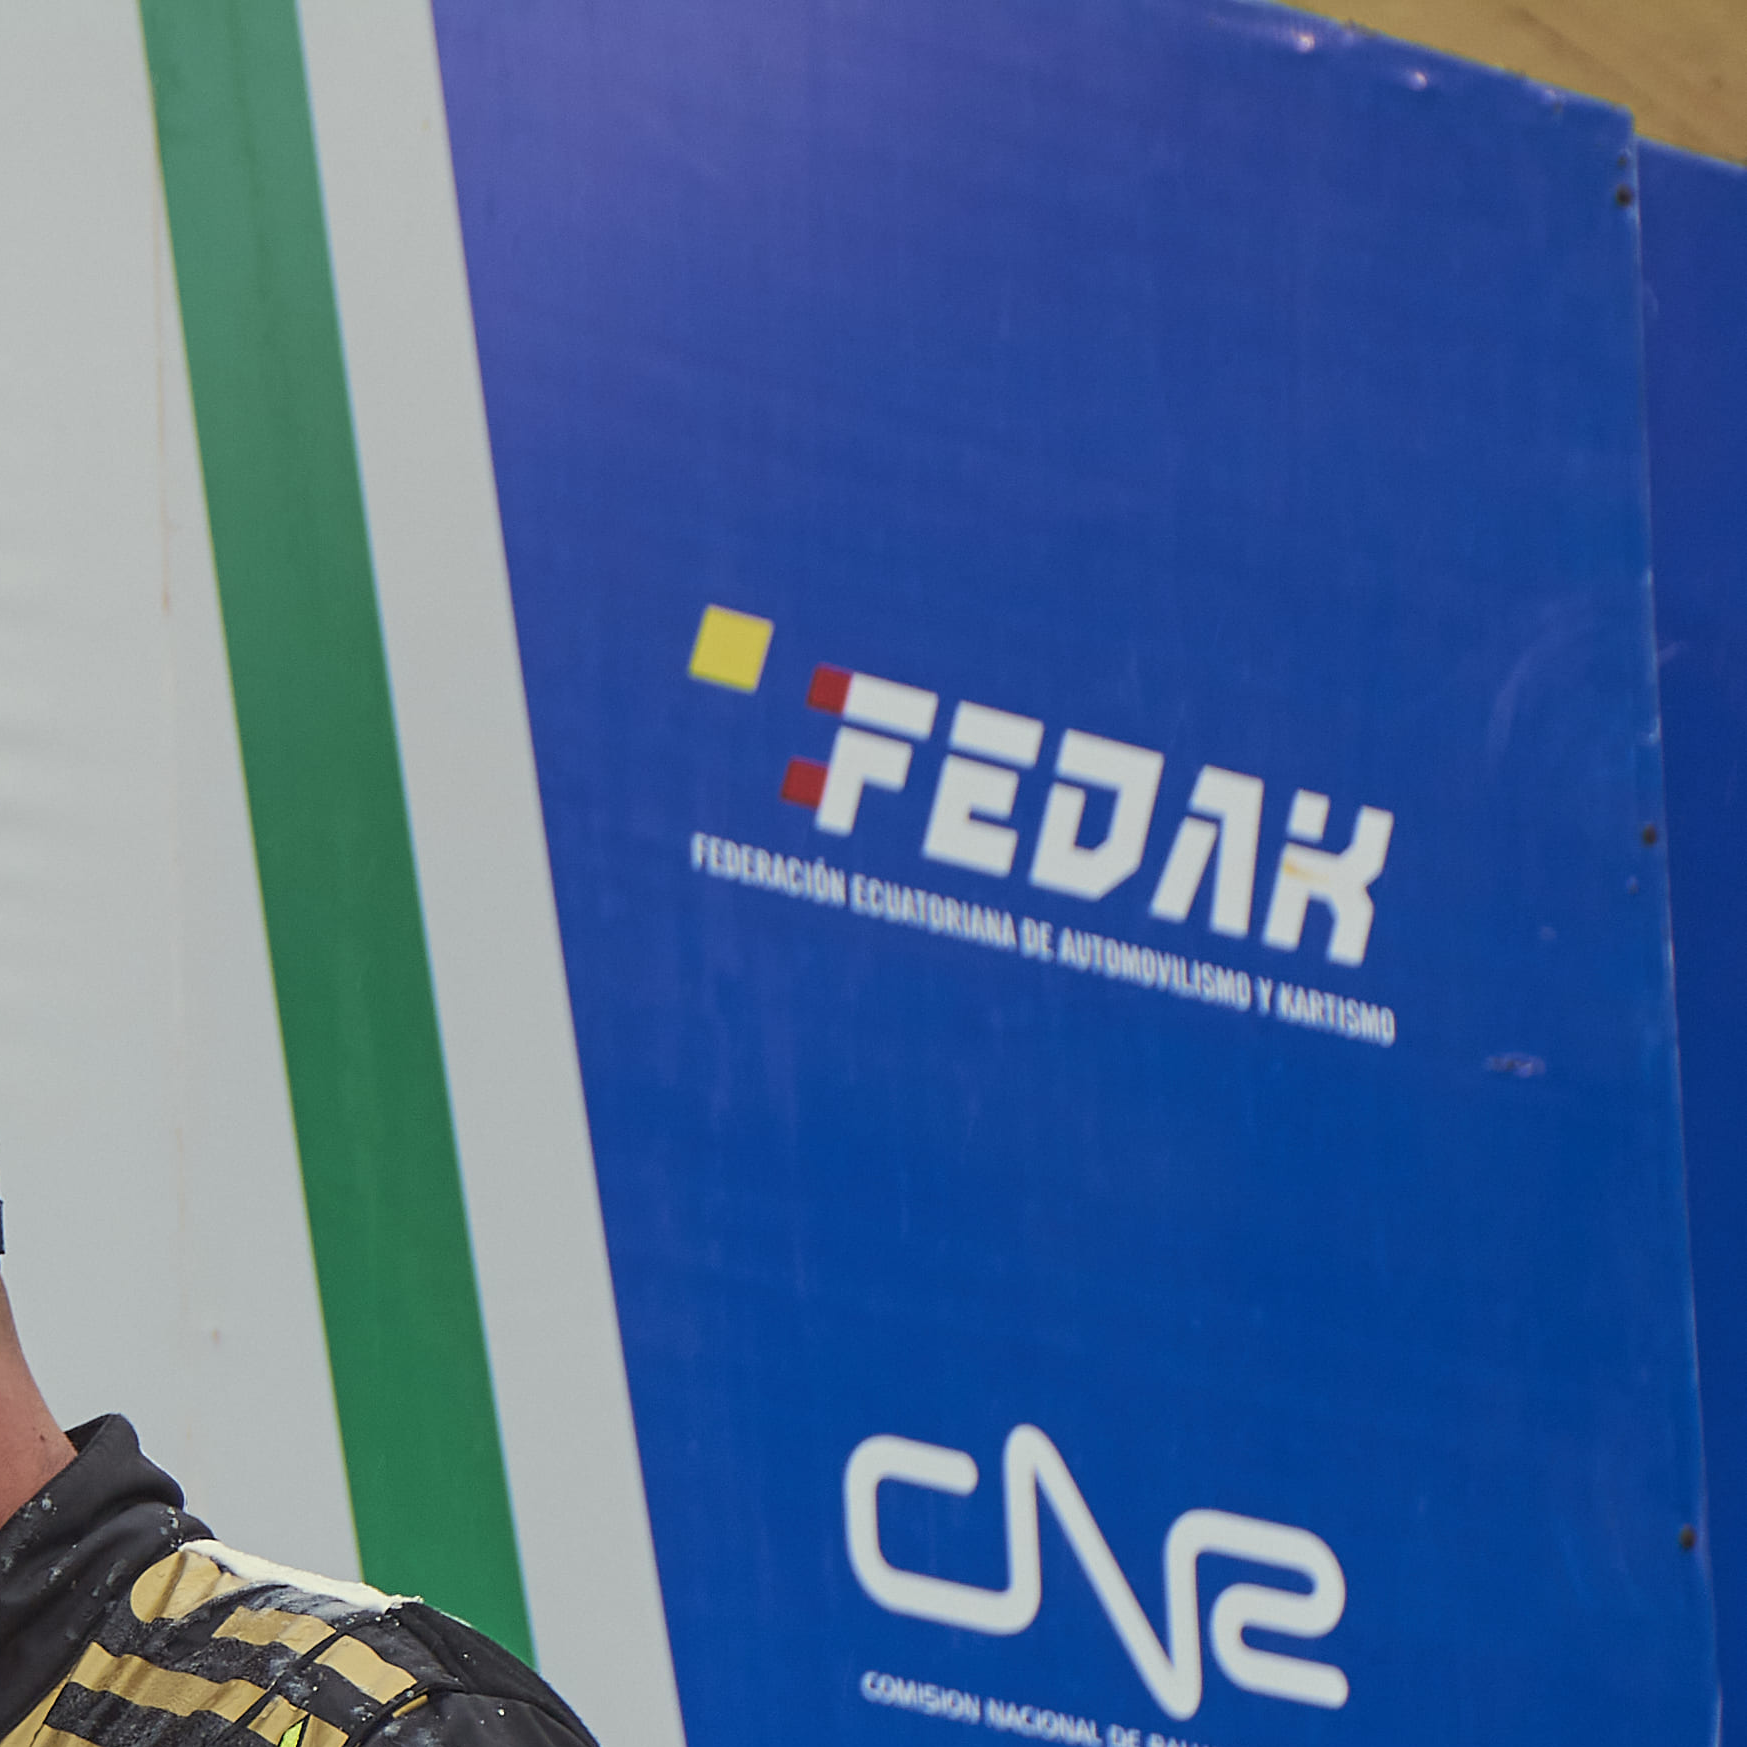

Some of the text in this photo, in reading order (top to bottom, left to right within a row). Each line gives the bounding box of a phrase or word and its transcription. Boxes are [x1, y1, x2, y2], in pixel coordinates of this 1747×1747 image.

[780, 662, 1394, 967] FEDAK
[691, 832, 1395, 1048] FEDERACIÓN ECUATORIANA DE AUTOMOVILISMO Y KARTISMO
[860, 1670, 980, 1726] COMISION
